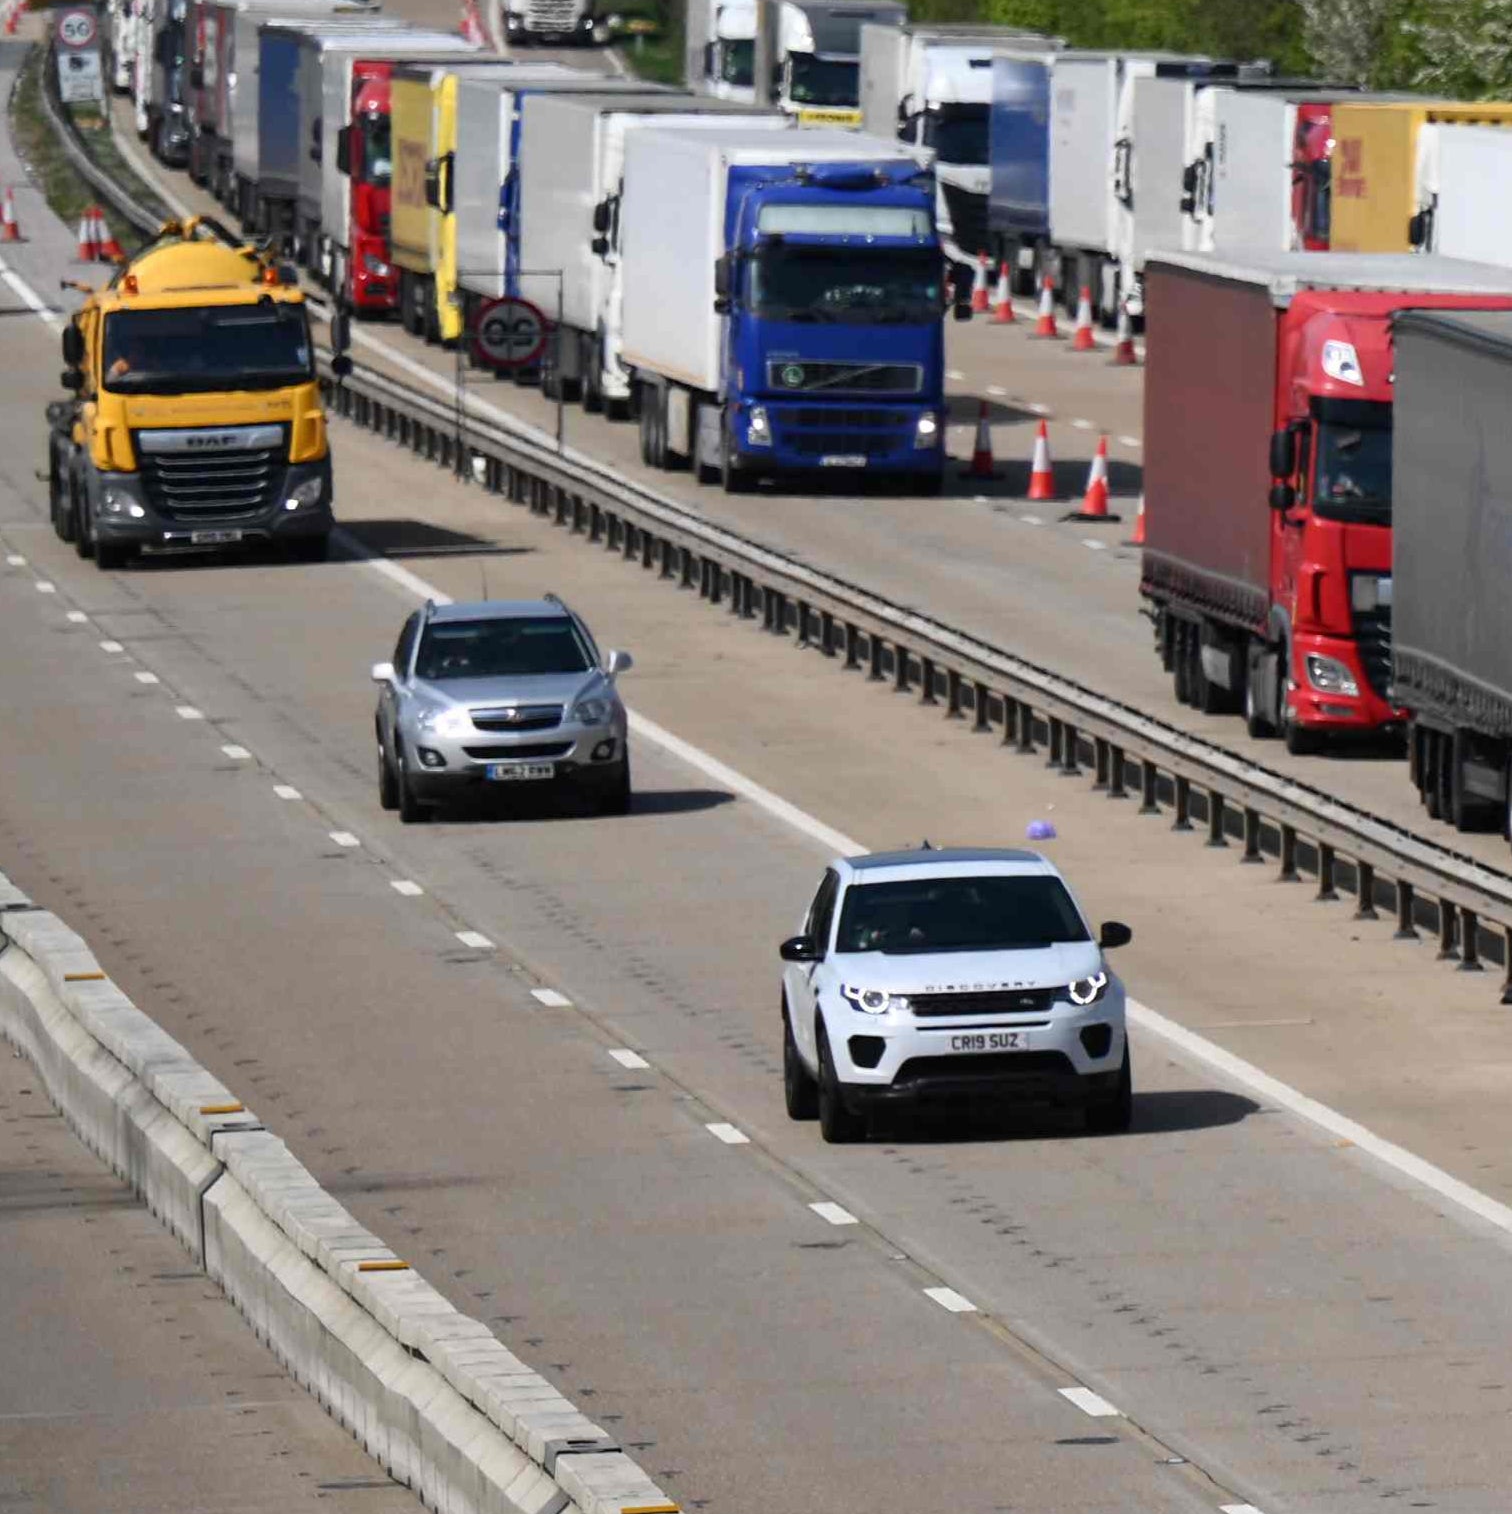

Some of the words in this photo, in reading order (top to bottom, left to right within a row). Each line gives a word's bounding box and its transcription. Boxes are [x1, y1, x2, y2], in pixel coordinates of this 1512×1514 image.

[926, 981, 1036, 992] DISCOVERY
[951, 1035, 986, 1051] CR19
[989, 1033, 1018, 1049] SUZ
